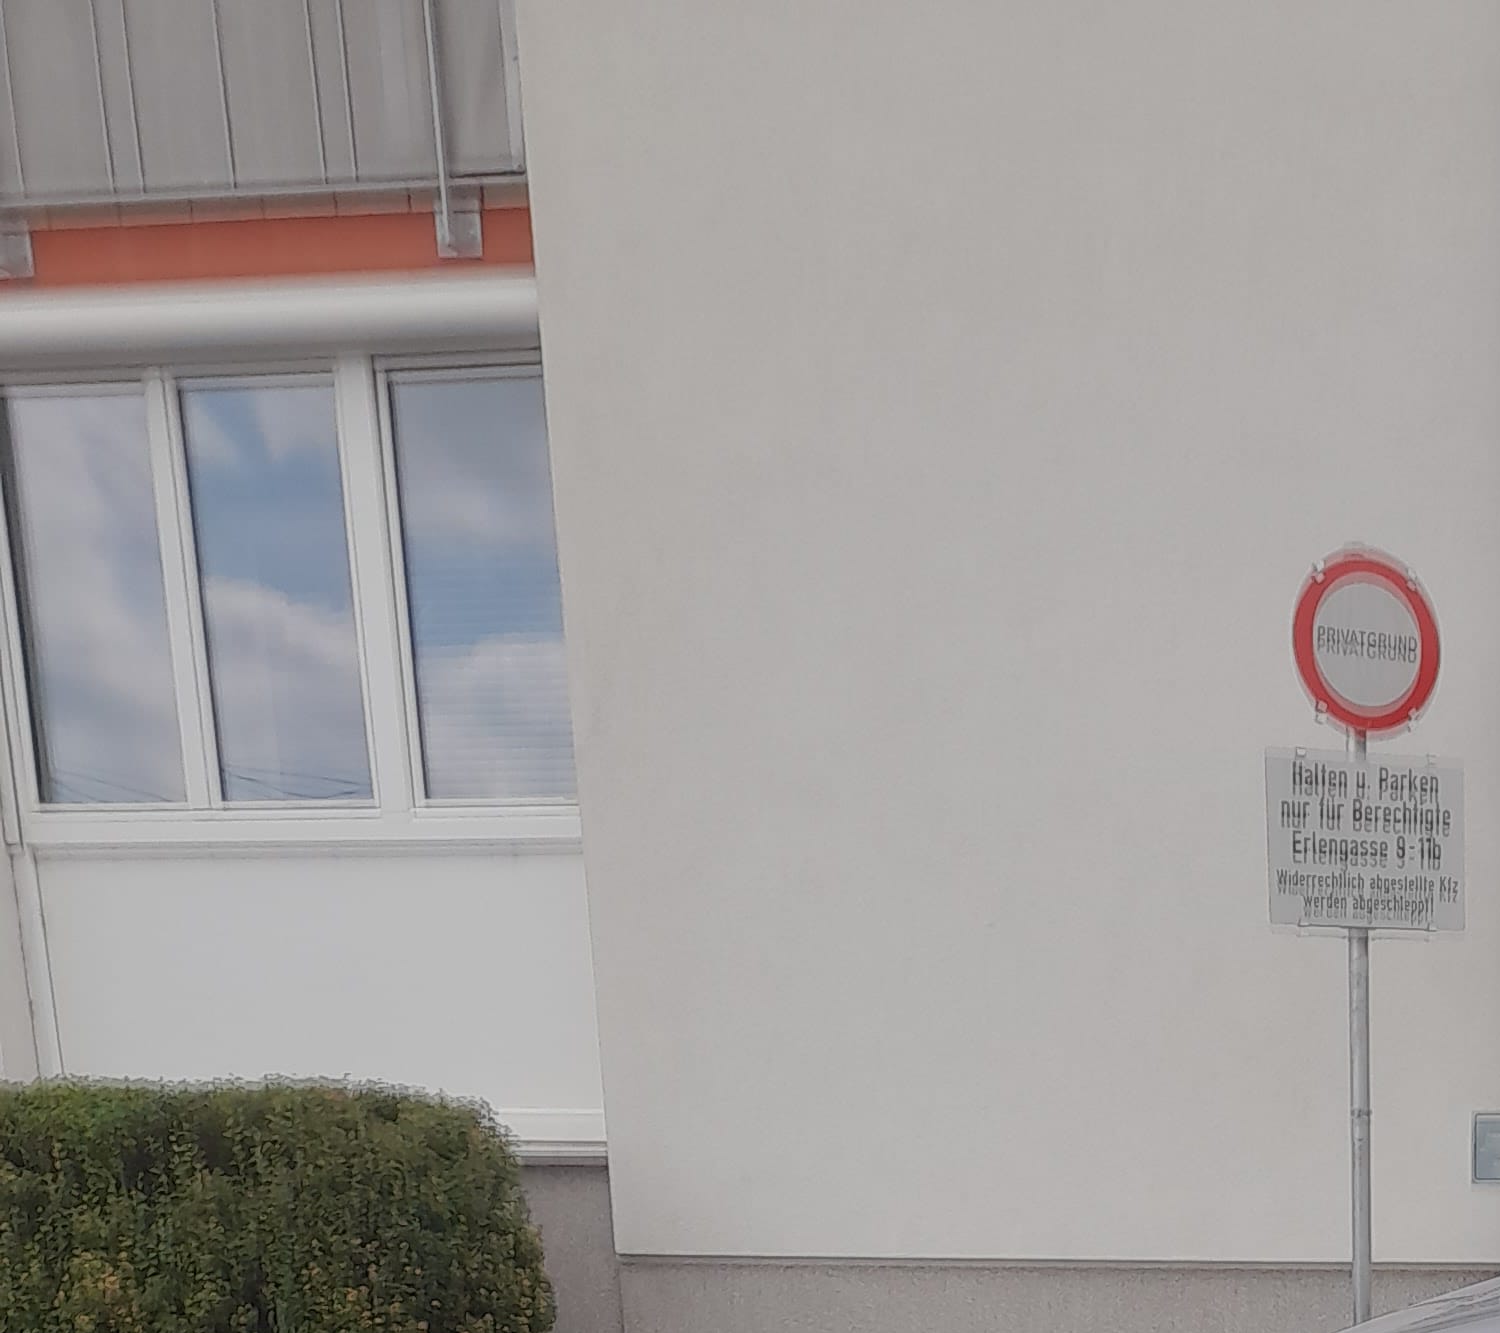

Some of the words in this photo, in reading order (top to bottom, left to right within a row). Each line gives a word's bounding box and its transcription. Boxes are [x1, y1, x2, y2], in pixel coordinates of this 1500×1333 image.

[1317, 625, 1418, 664] PRIVATGRUND
[1292, 761, 1348, 799] Halten
[1356, 770, 1371, 800] u.
[1379, 767, 1439, 803] Parken
[1281, 800, 1310, 829] nur
[1319, 797, 1345, 831] für
[1353, 798, 1451, 838] Berechtigte
[1292, 830, 1388, 869] Erlengasse
[1276, 869, 1365, 896] Widerrechtlich
[1370, 874, 1435, 900] abgestellte
[1440, 876, 1459, 903] Kfz
[1303, 893, 1347, 918] werden
